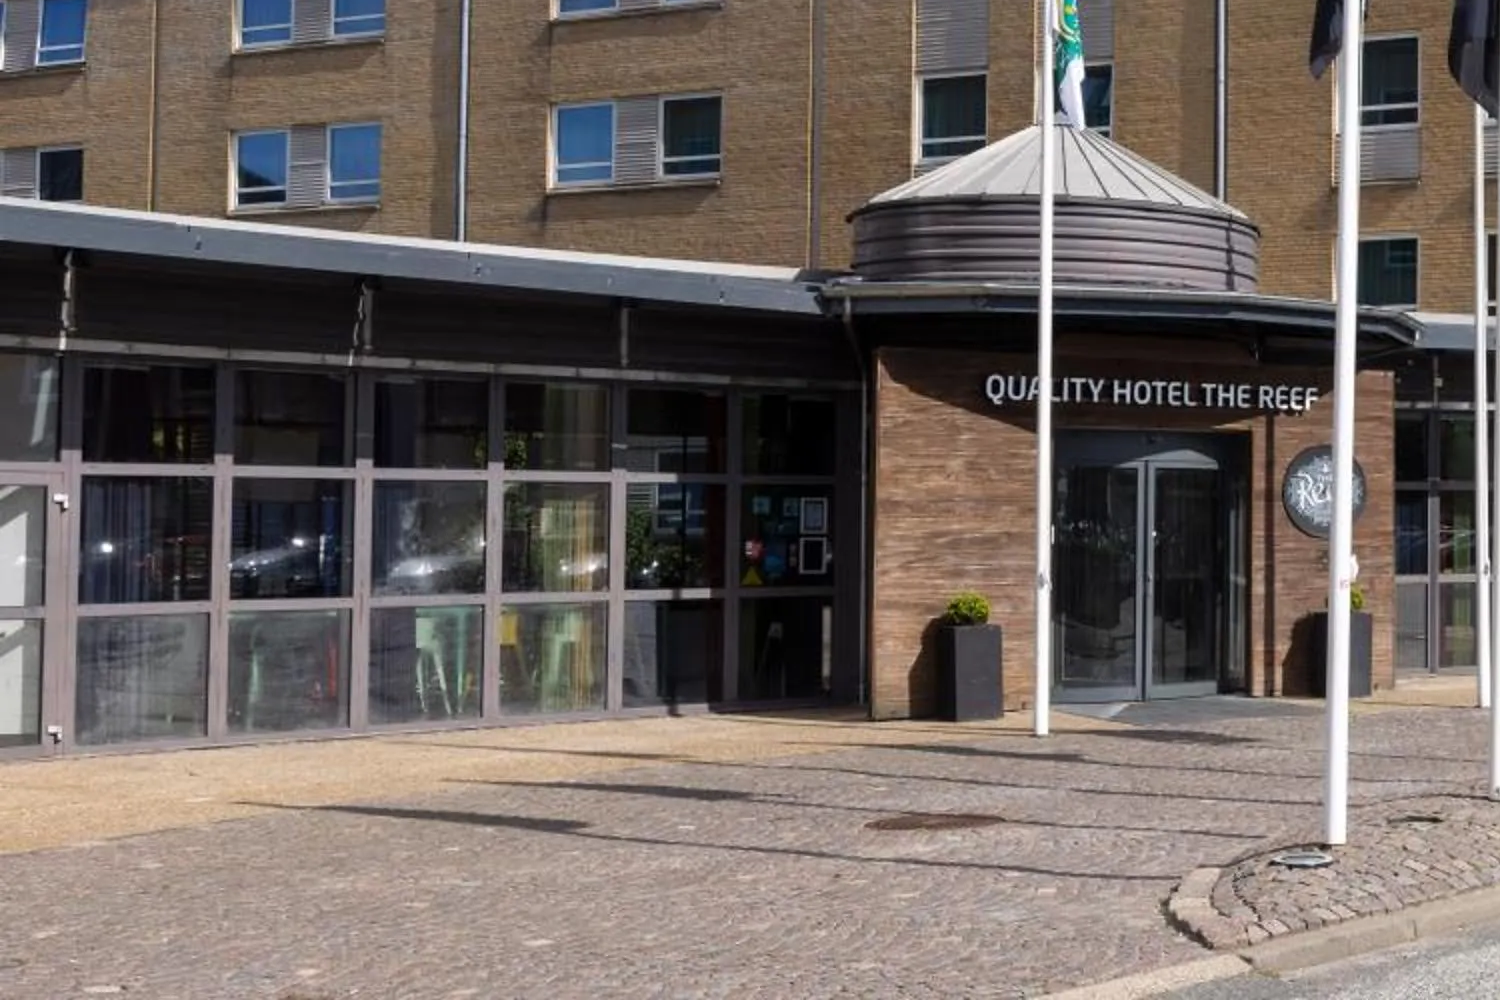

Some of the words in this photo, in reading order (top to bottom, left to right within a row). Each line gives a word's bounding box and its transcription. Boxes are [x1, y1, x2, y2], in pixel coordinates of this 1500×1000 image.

[1113, 379, 1198, 406] HOTEL
[1202, 383, 1251, 408] THE
[1259, 385, 1319, 410] REEF
